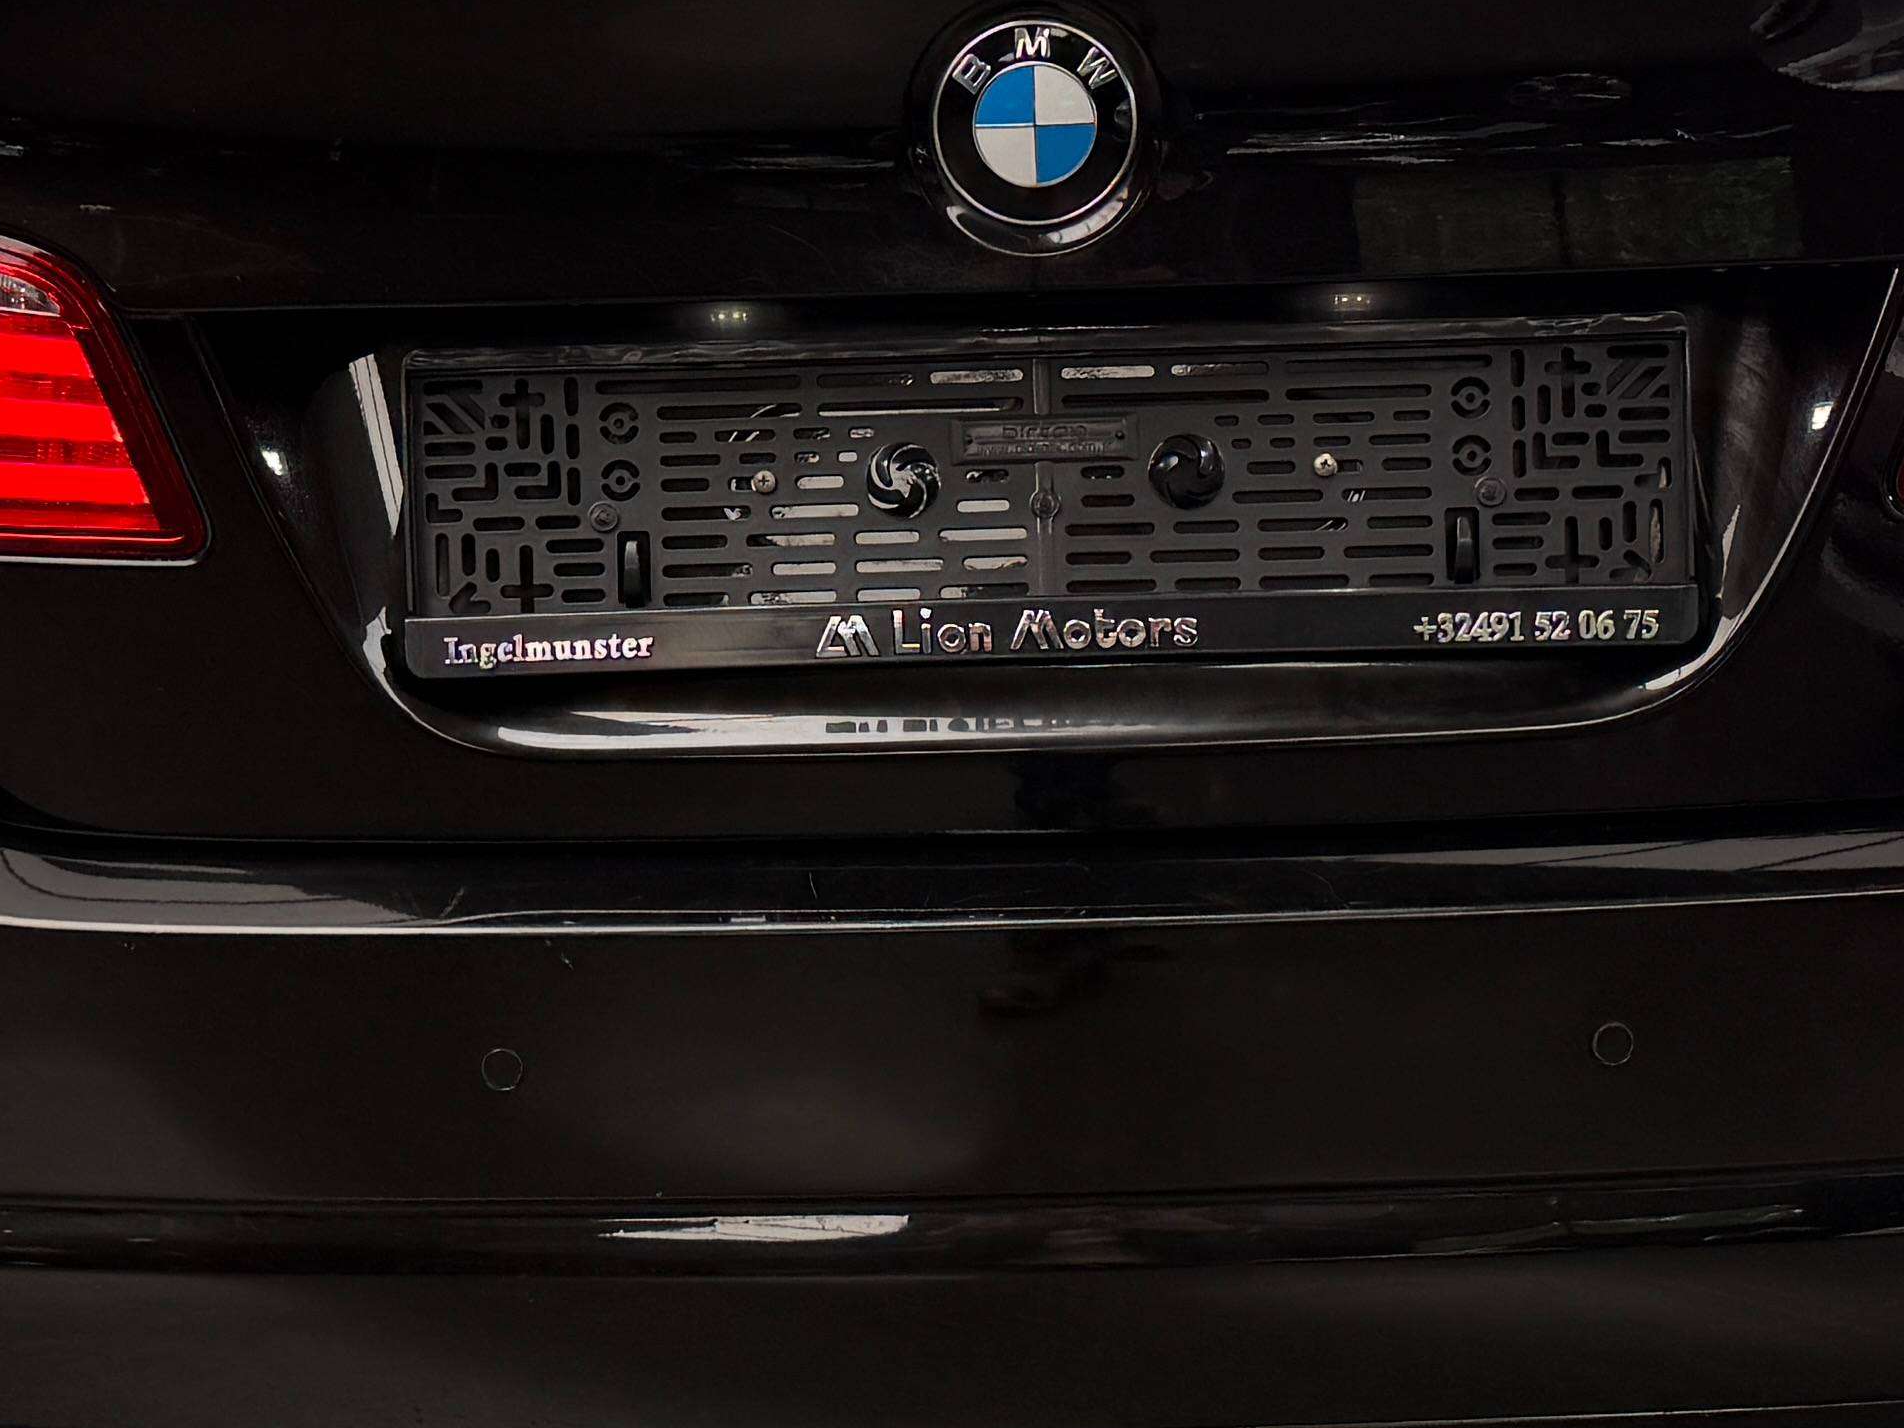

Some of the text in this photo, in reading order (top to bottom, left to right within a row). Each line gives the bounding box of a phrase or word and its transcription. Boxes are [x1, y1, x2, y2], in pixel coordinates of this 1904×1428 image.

[952, 27, 1119, 95] BMW
[893, 607, 993, 655] Lion
[1010, 608, 1198, 651] Motors
[1413, 609, 1660, 643] +32491 52 06 75
